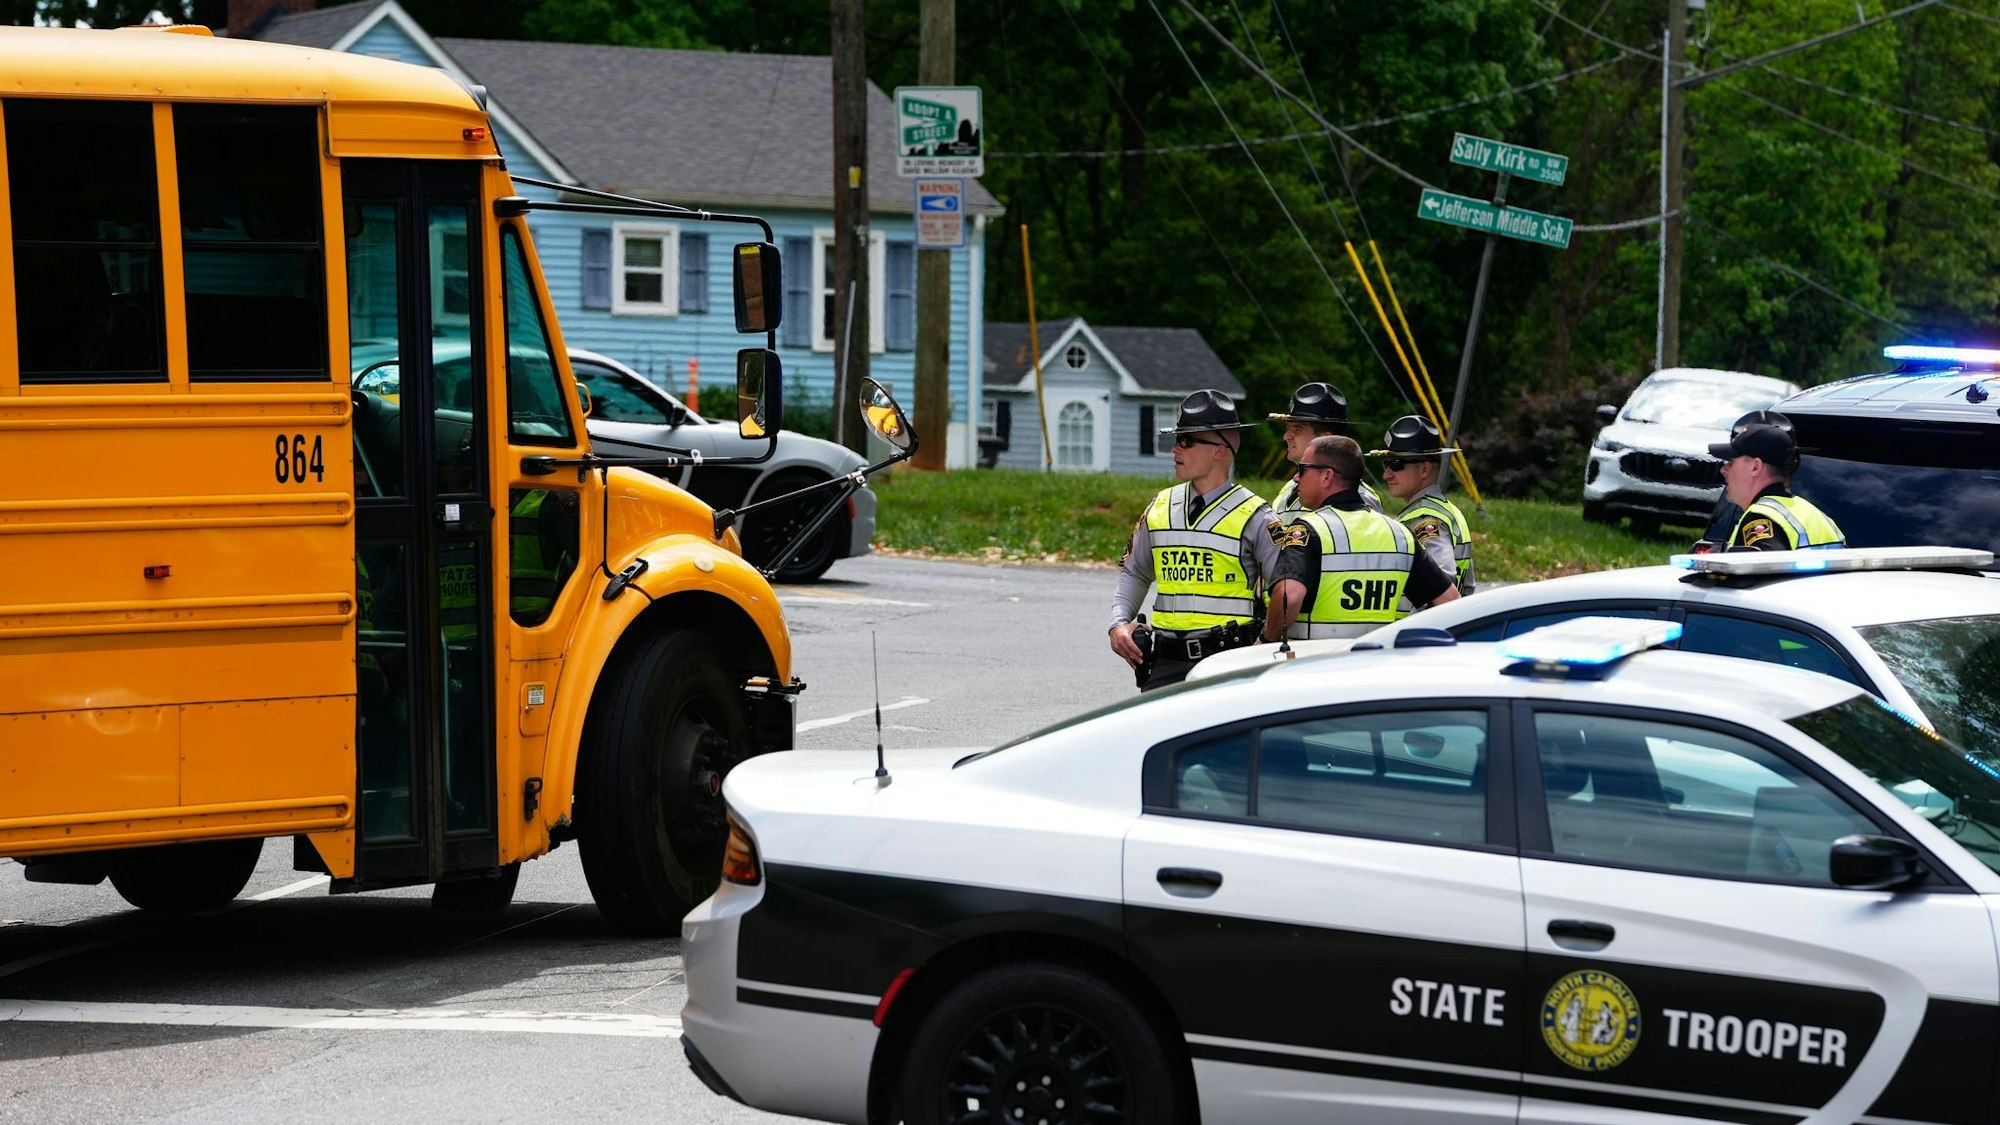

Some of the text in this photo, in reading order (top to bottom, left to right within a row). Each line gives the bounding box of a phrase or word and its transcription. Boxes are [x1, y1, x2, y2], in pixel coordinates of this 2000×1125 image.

[908, 102, 953, 120] ADOPT A
[912, 125, 947, 141] STREET
[1454, 137, 1540, 171] Sally Kirk RD
[1547, 157, 1561, 169] NW
[1540, 168, 1563, 182] 3500
[1436, 198, 1566, 243] Jefferson Middle Sch.
[275, 434, 324, 484] 864
[1161, 551, 1214, 567] STATE
[1161, 567, 1214, 583] TROOPER
[1340, 579, 1397, 611] SHP
[1389, 977, 1506, 1027] STATE
[1547, 973, 1638, 1018] NORTH CAROLINA
[1663, 1008, 1847, 1067] TROOPER
[1595, 1038, 1634, 1069] PATROL
